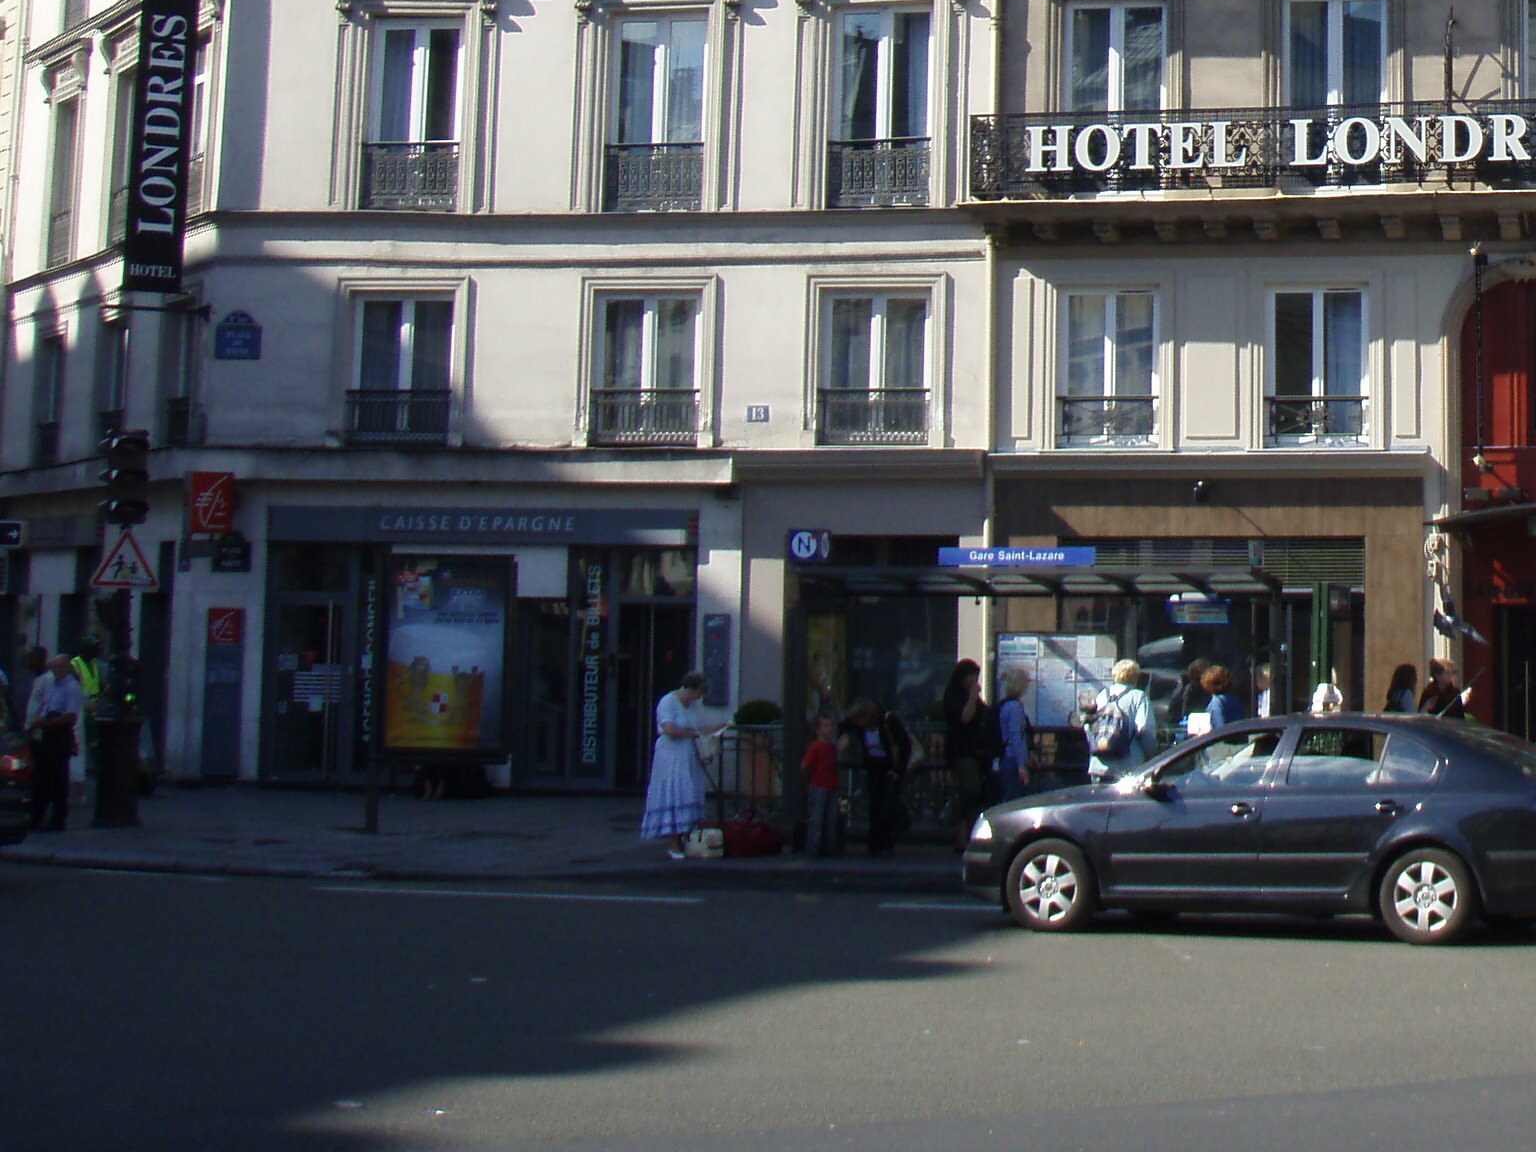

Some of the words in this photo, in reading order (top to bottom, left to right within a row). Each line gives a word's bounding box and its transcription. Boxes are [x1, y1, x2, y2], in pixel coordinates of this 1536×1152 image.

[136, 13, 190, 236] LONDRES
[1024, 120, 1247, 172] HOTEL
[129, 263, 176, 279] HOTEL
[752, 407, 765, 421] 13
[380, 515, 450, 530] CAISSE
[459, 516, 576, 531] D'EPARGNE
[798, 536, 811, 553] N
[969, 550, 994, 561] Gare
[998, 550, 1065, 561] Saint-Lazare
[587, 565, 602, 626] BILLETS
[587, 632, 600, 648] de
[583, 655, 599, 764] DISTRIBUTEUR
